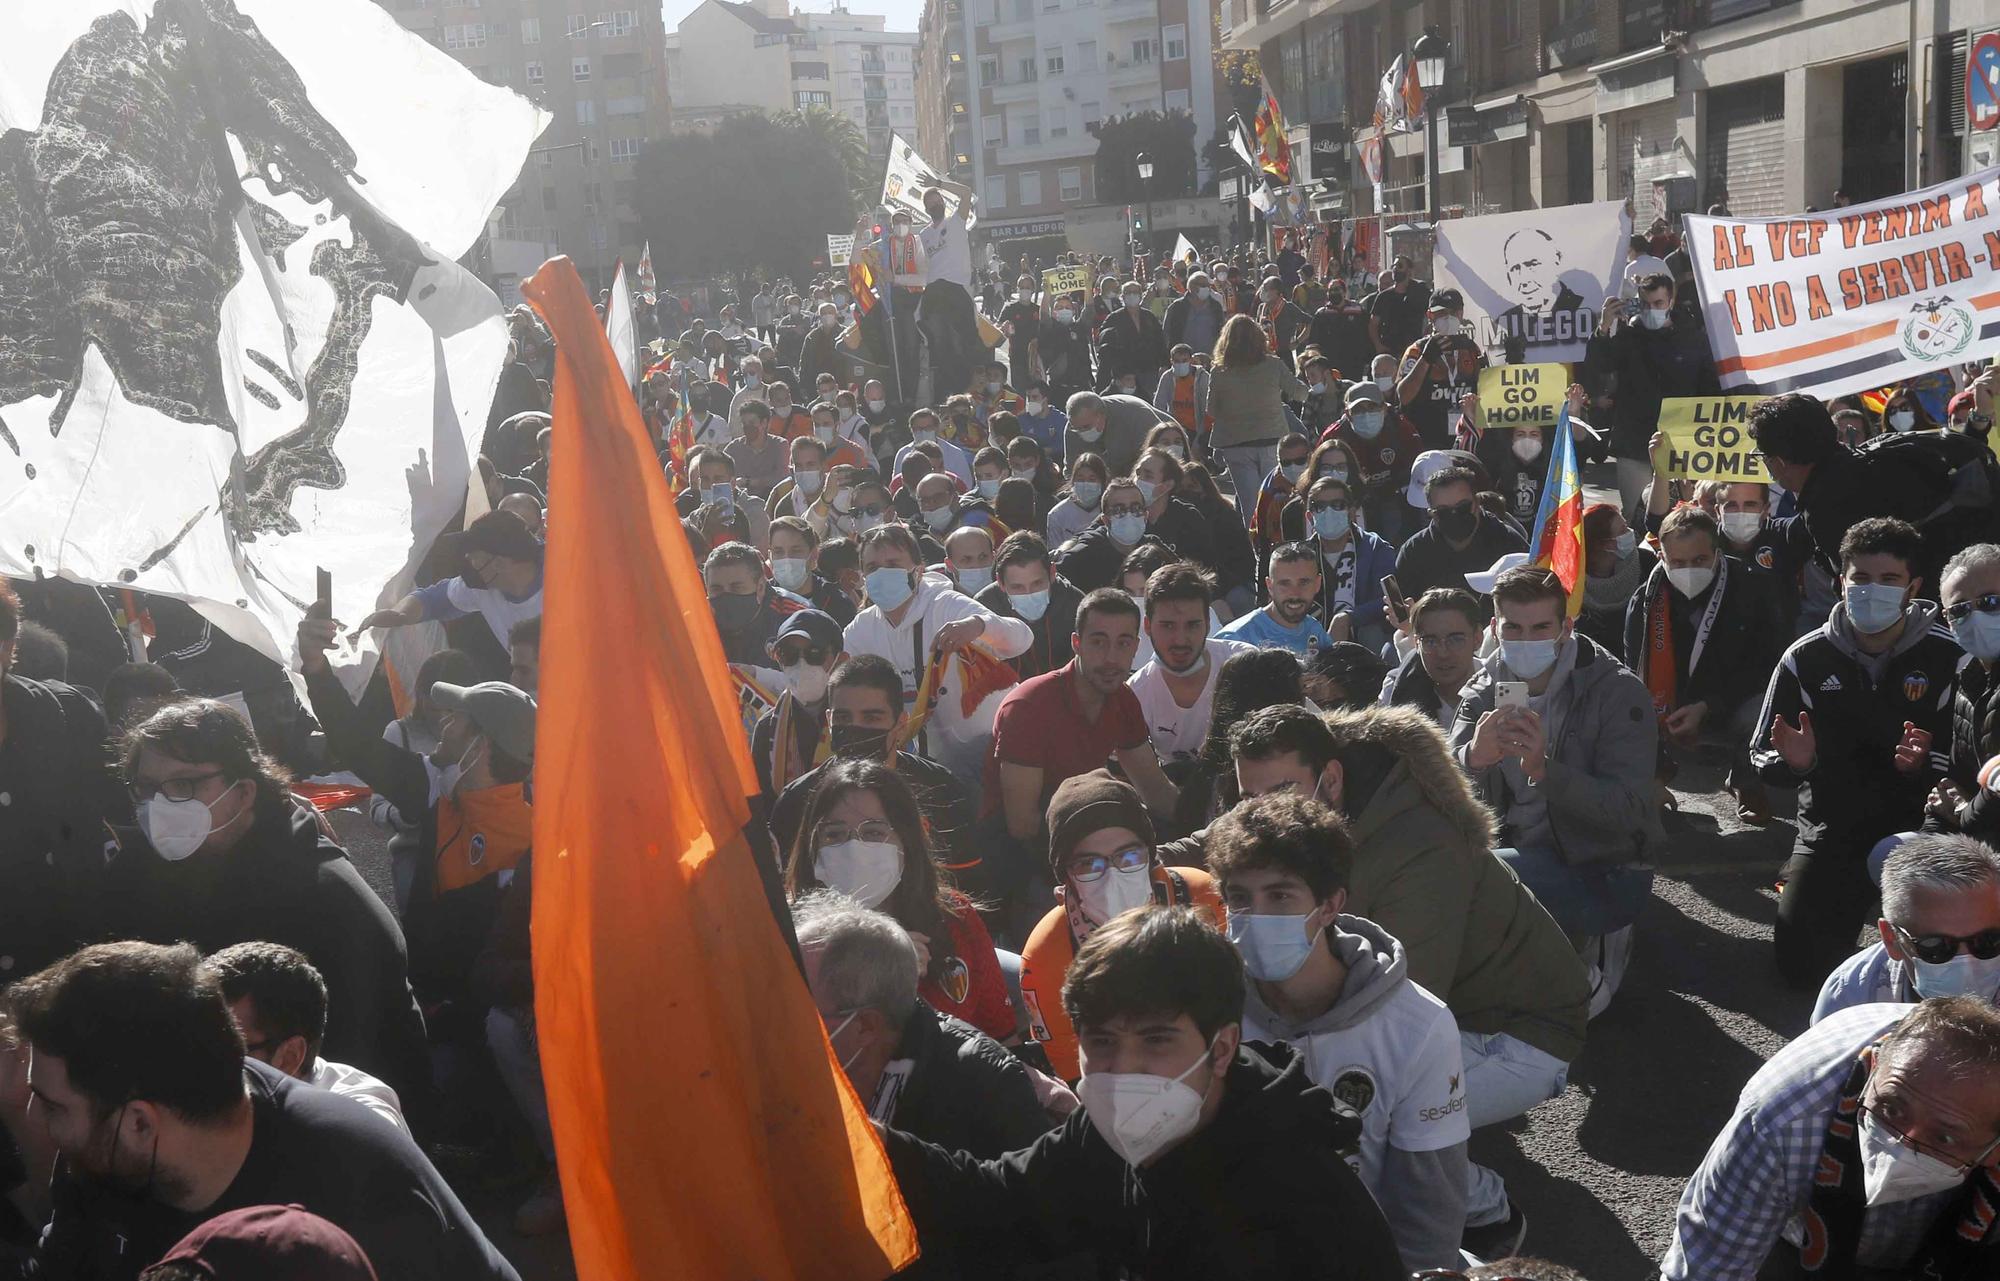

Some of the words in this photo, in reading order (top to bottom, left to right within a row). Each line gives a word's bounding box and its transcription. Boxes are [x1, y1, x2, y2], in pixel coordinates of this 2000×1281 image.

[991, 226, 1012, 237] BAR
[1015, 225, 1028, 235] LA
[1712, 225, 1755, 270] AL
[1766, 219, 1828, 262] VCF
[1838, 193, 1952, 249] VENIM
[1963, 183, 1988, 221] A
[1058, 271, 1075, 281] GO
[1051, 279, 1085, 292] HOME
[1747, 280, 1797, 333] NO
[1806, 274, 1833, 320] A
[1501, 368, 1540, 386] LIM
[1503, 387, 1537, 403] GO
[1487, 405, 1554, 423] HOME
[1693, 402, 1747, 423] LIM
[1694, 426, 1740, 448] GO
[1668, 450, 1760, 476] HOME
